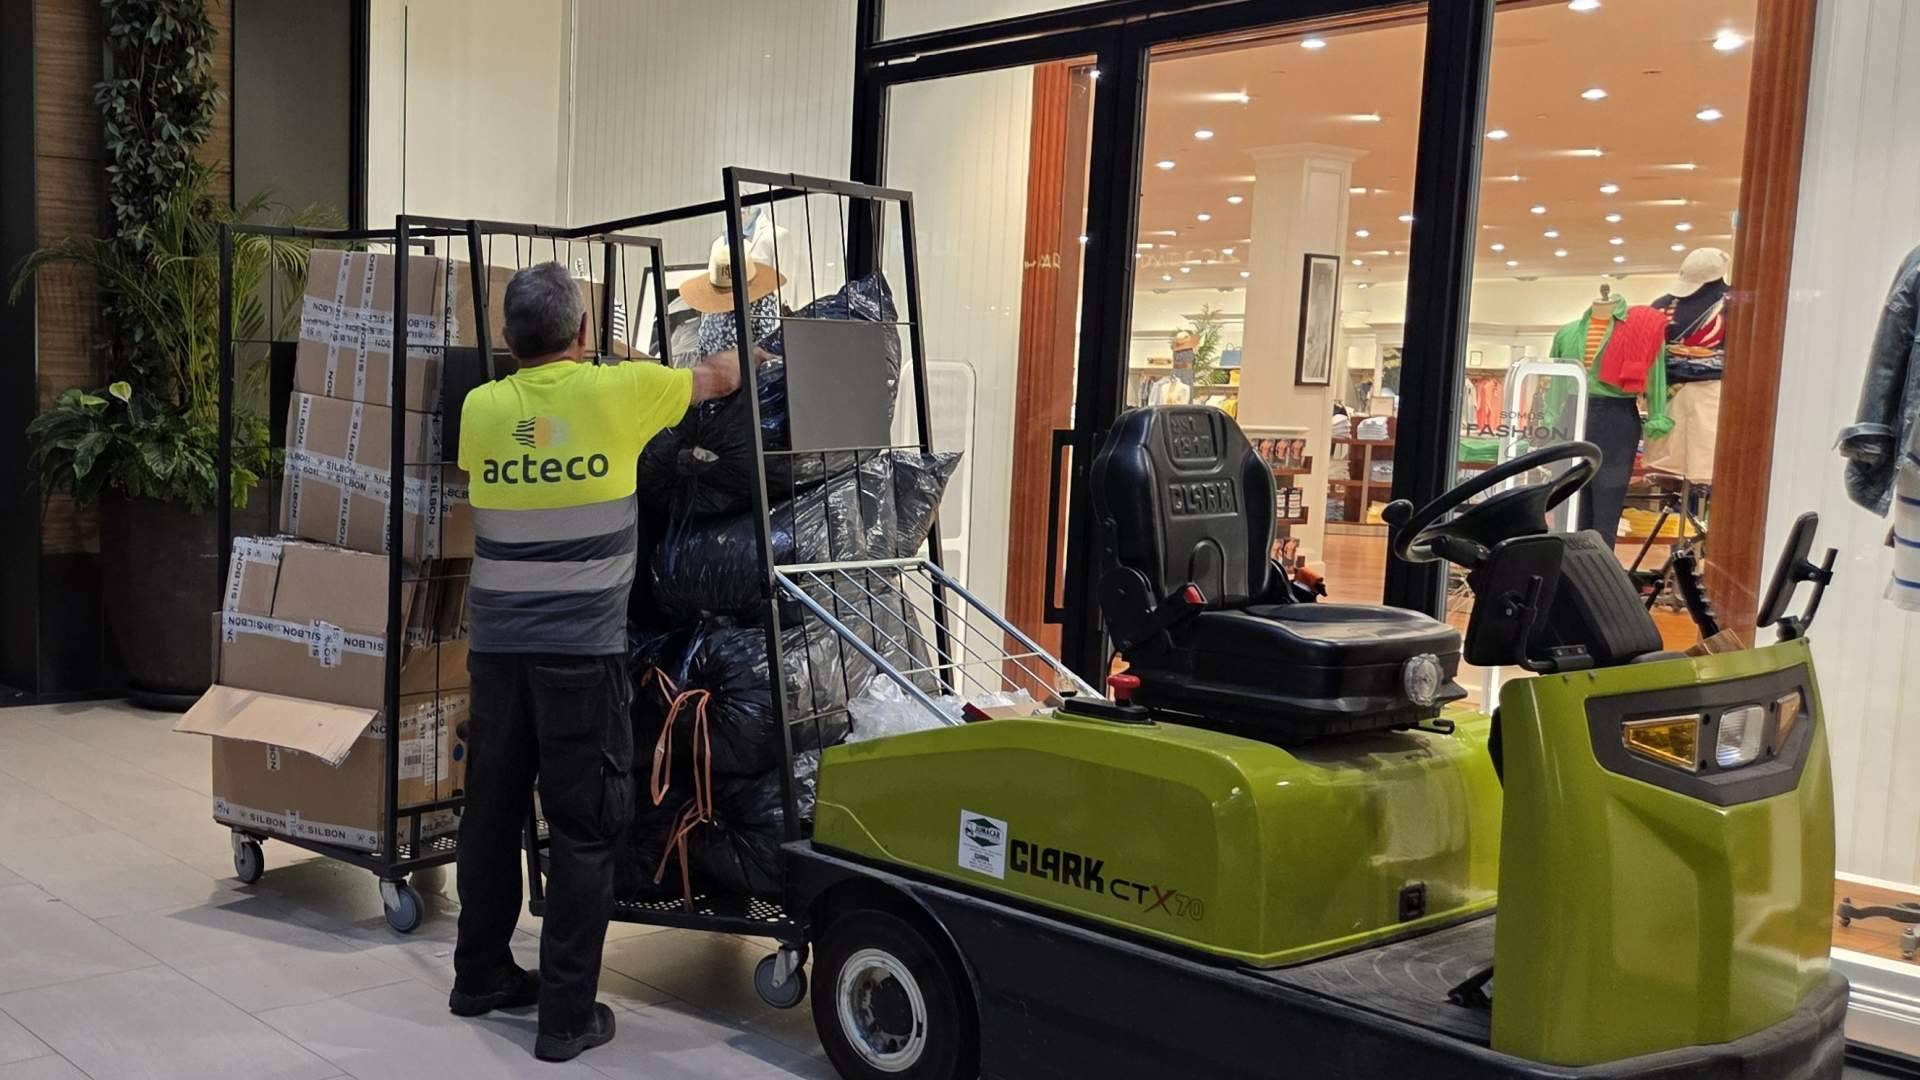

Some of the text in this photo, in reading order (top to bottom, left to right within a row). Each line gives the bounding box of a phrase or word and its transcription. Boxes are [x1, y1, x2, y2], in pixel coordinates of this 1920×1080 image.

[364, 253, 375, 294] SILBO
[407, 318, 436, 330] SILBO
[1499, 410, 1545, 420] SOMOS
[1465, 423, 1568, 439] FASHION
[483, 453, 609, 484] acteco
[429, 475, 439, 525] SILBON
[1168, 482, 1234, 514] CLARK
[231, 551, 245, 600] SILBON
[343, 636, 385, 652] SILBON
[249, 812, 347, 841] SILBON SILBON
[1010, 838, 1205, 911] CLARK CTX70
